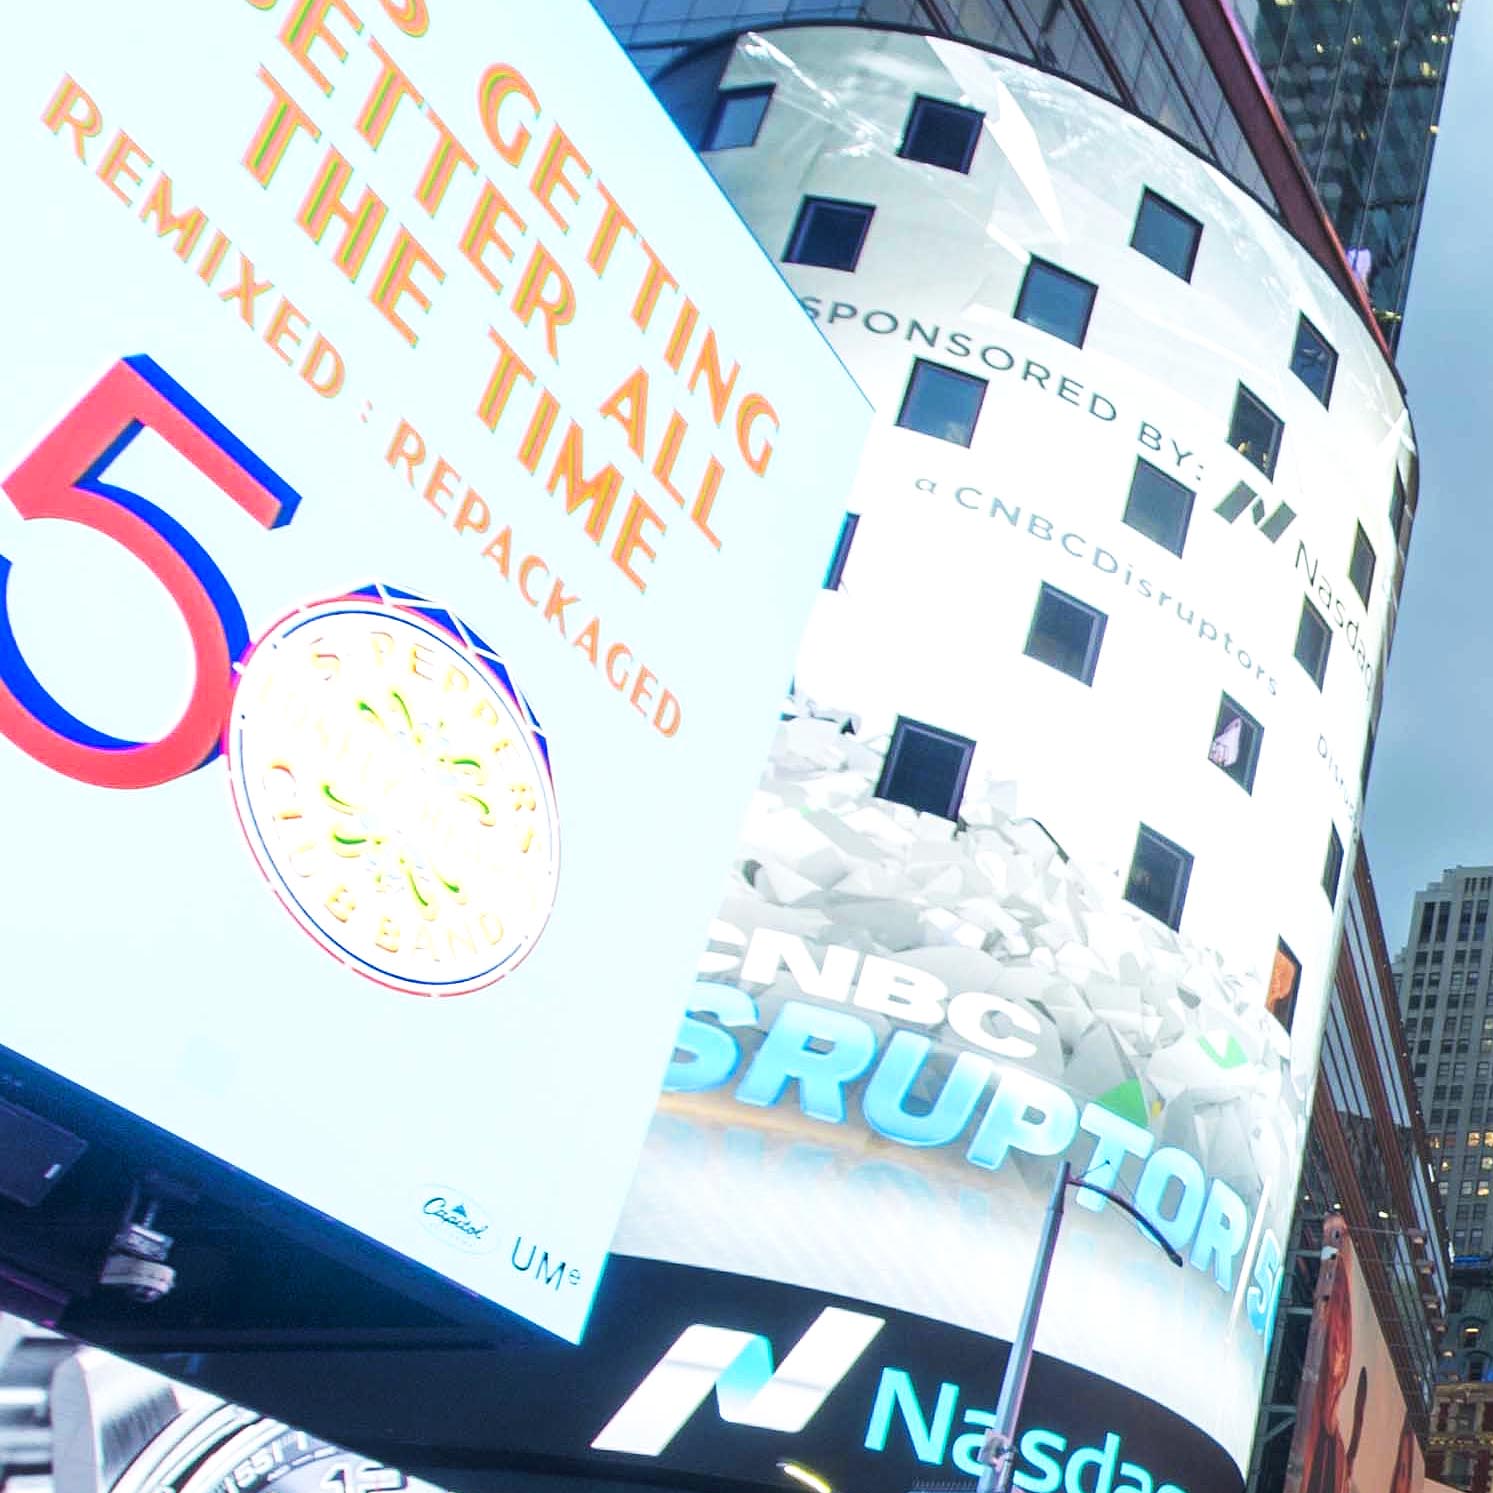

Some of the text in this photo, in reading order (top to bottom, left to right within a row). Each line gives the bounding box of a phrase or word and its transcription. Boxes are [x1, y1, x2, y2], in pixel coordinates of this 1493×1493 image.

[41, 72, 347, 400] REMIXED
[384, 418, 682, 740] REPACKAGED
[239, 62, 666, 595] THE TIME
[244, 0, 724, 552] ETTER ALL
[476, 62, 780, 478] GETTING
[800, 295, 1204, 482] SPONSORED BY:
